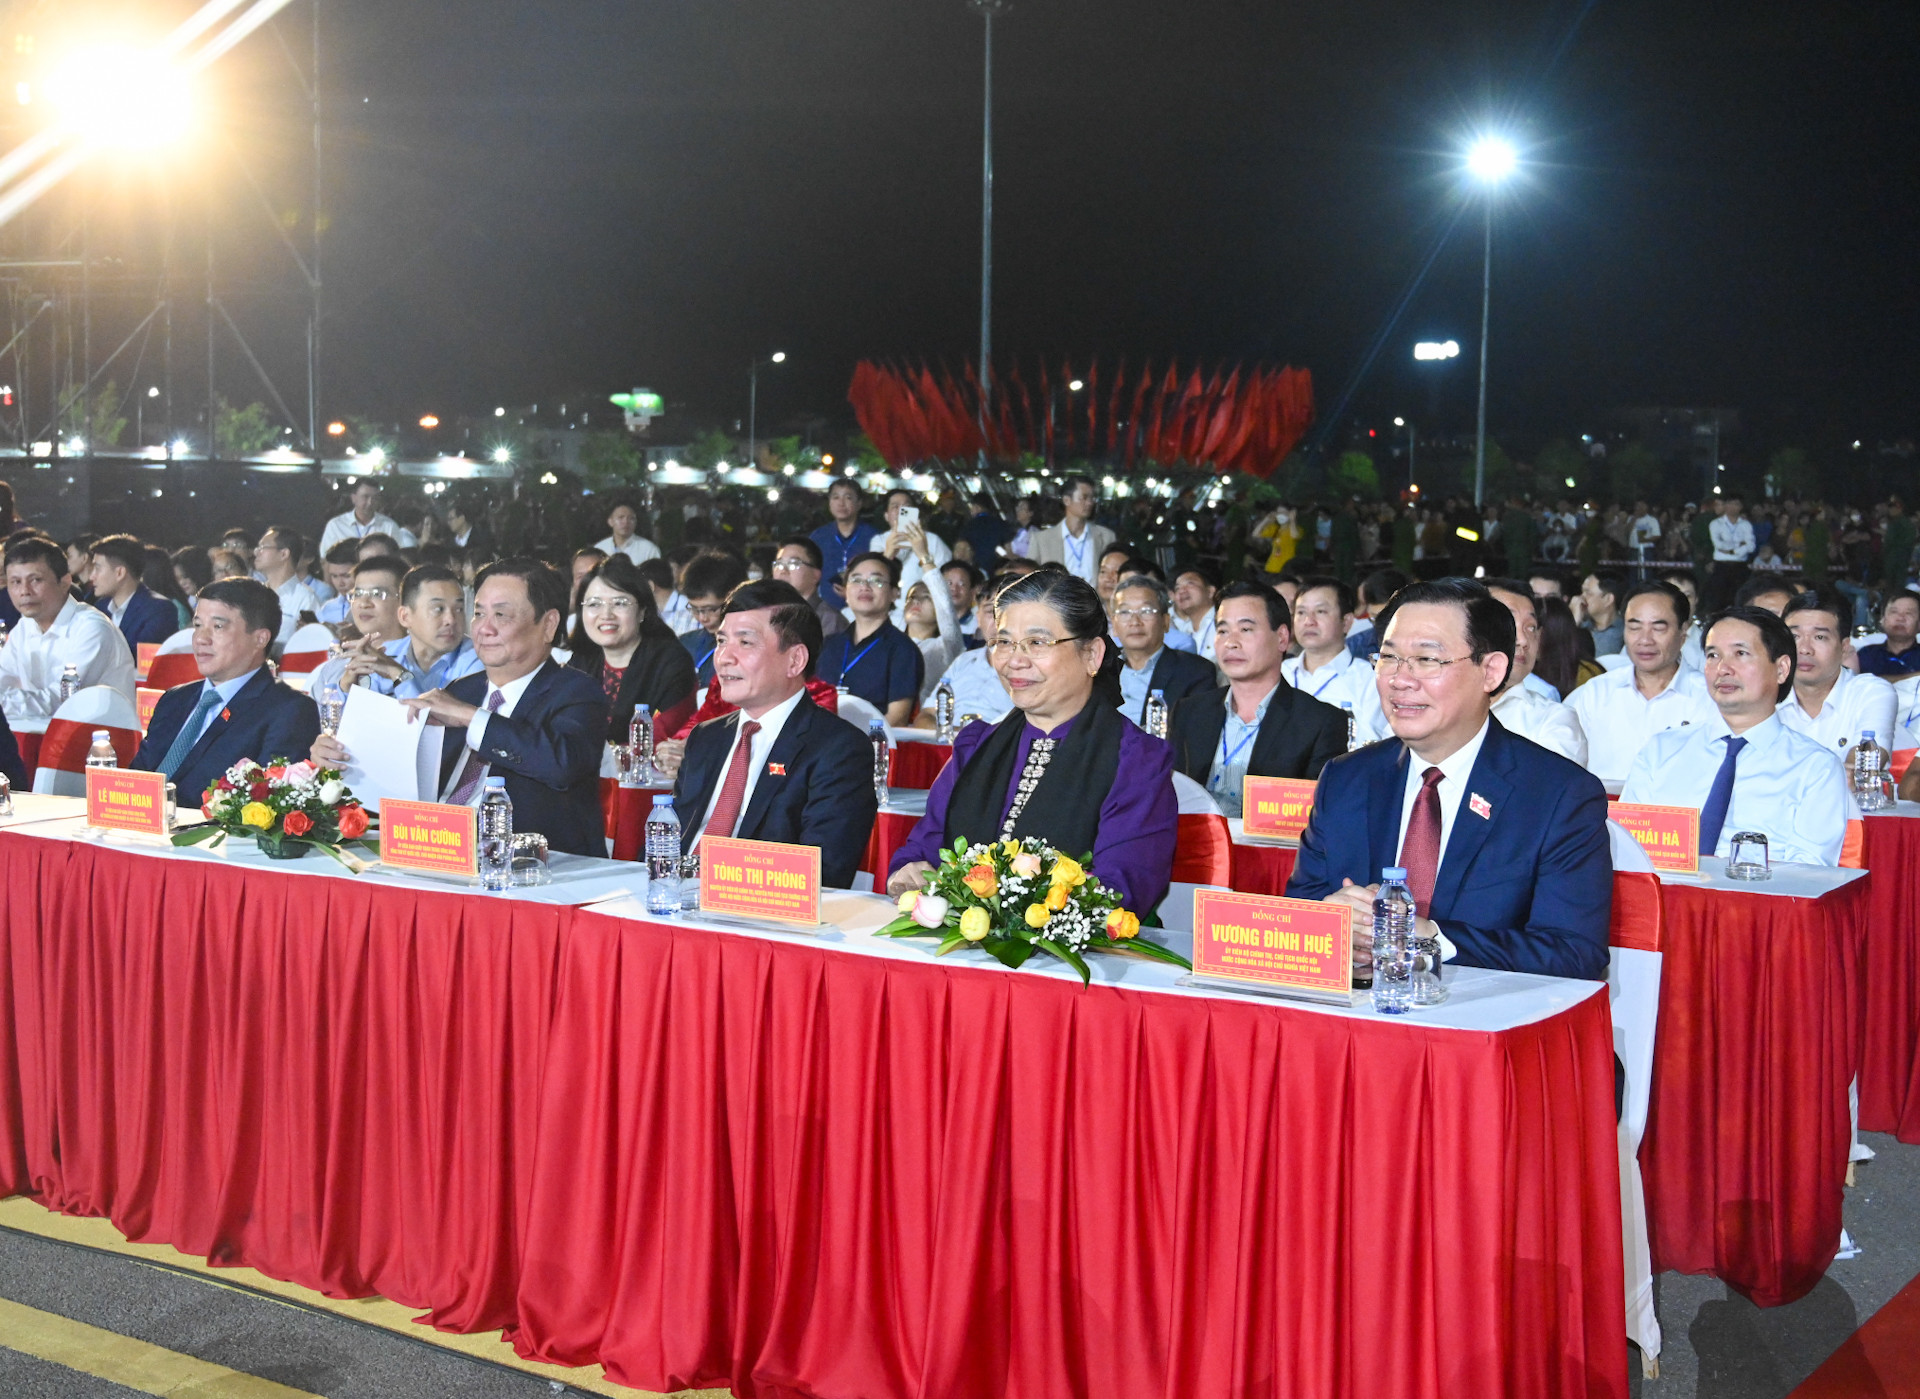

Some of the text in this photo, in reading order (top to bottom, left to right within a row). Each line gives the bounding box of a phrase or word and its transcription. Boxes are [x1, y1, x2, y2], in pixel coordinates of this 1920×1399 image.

[98, 787, 153, 808] LÊ MINH HOAN
[1258, 801, 1279, 815] MAI
[393, 823, 461, 847] BÙI VĂN CƯỜNG
[1662, 829, 1680, 847] HÀ
[744, 854, 774, 865] ĐỒNG CHÍ
[713, 861, 806, 890] TÒNG THỊ PHÓNG
[1252, 909, 1291, 923] ĐỒNG CHÍ
[1211, 923, 1333, 958] VƯƠNG ĐÌNH HUỆ
